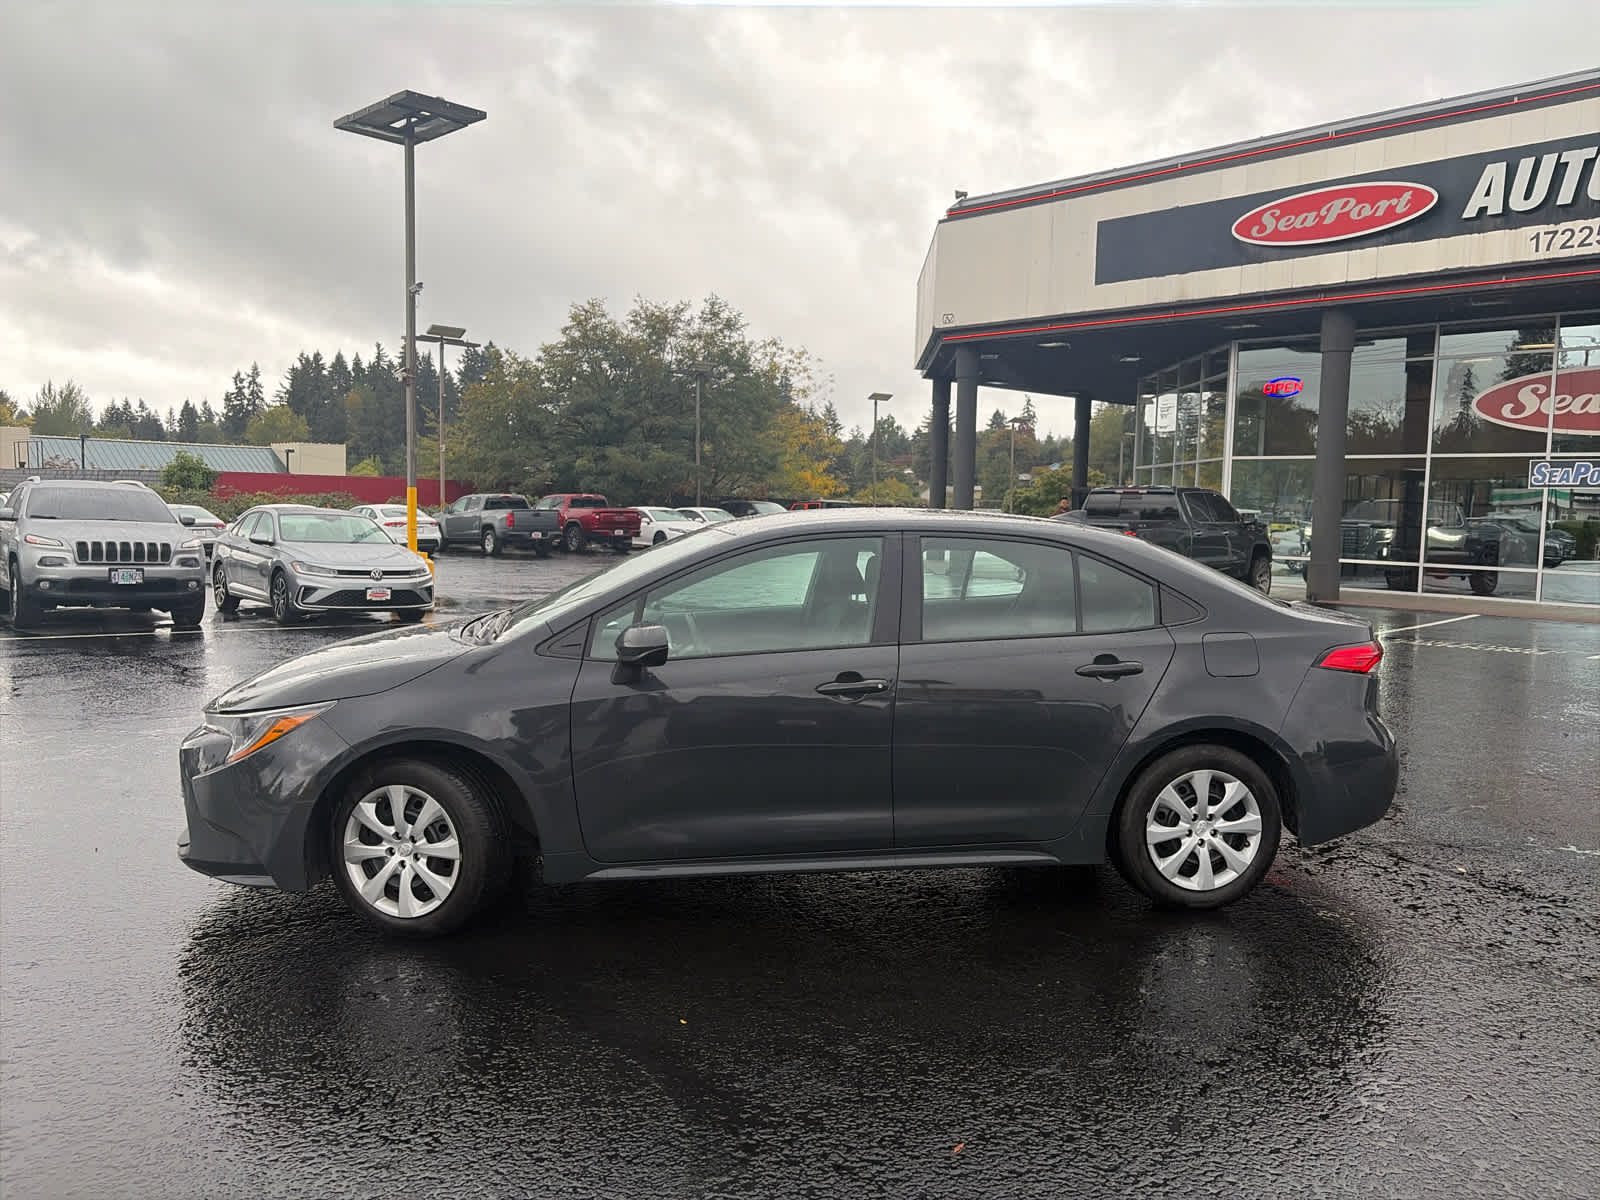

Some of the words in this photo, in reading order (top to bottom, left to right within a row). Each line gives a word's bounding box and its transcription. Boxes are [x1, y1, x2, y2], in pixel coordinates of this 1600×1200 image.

[1462, 146, 1600, 218] AUT
[1251, 190, 1413, 238] SeaPort
[1263, 380, 1304, 395] OPEN
